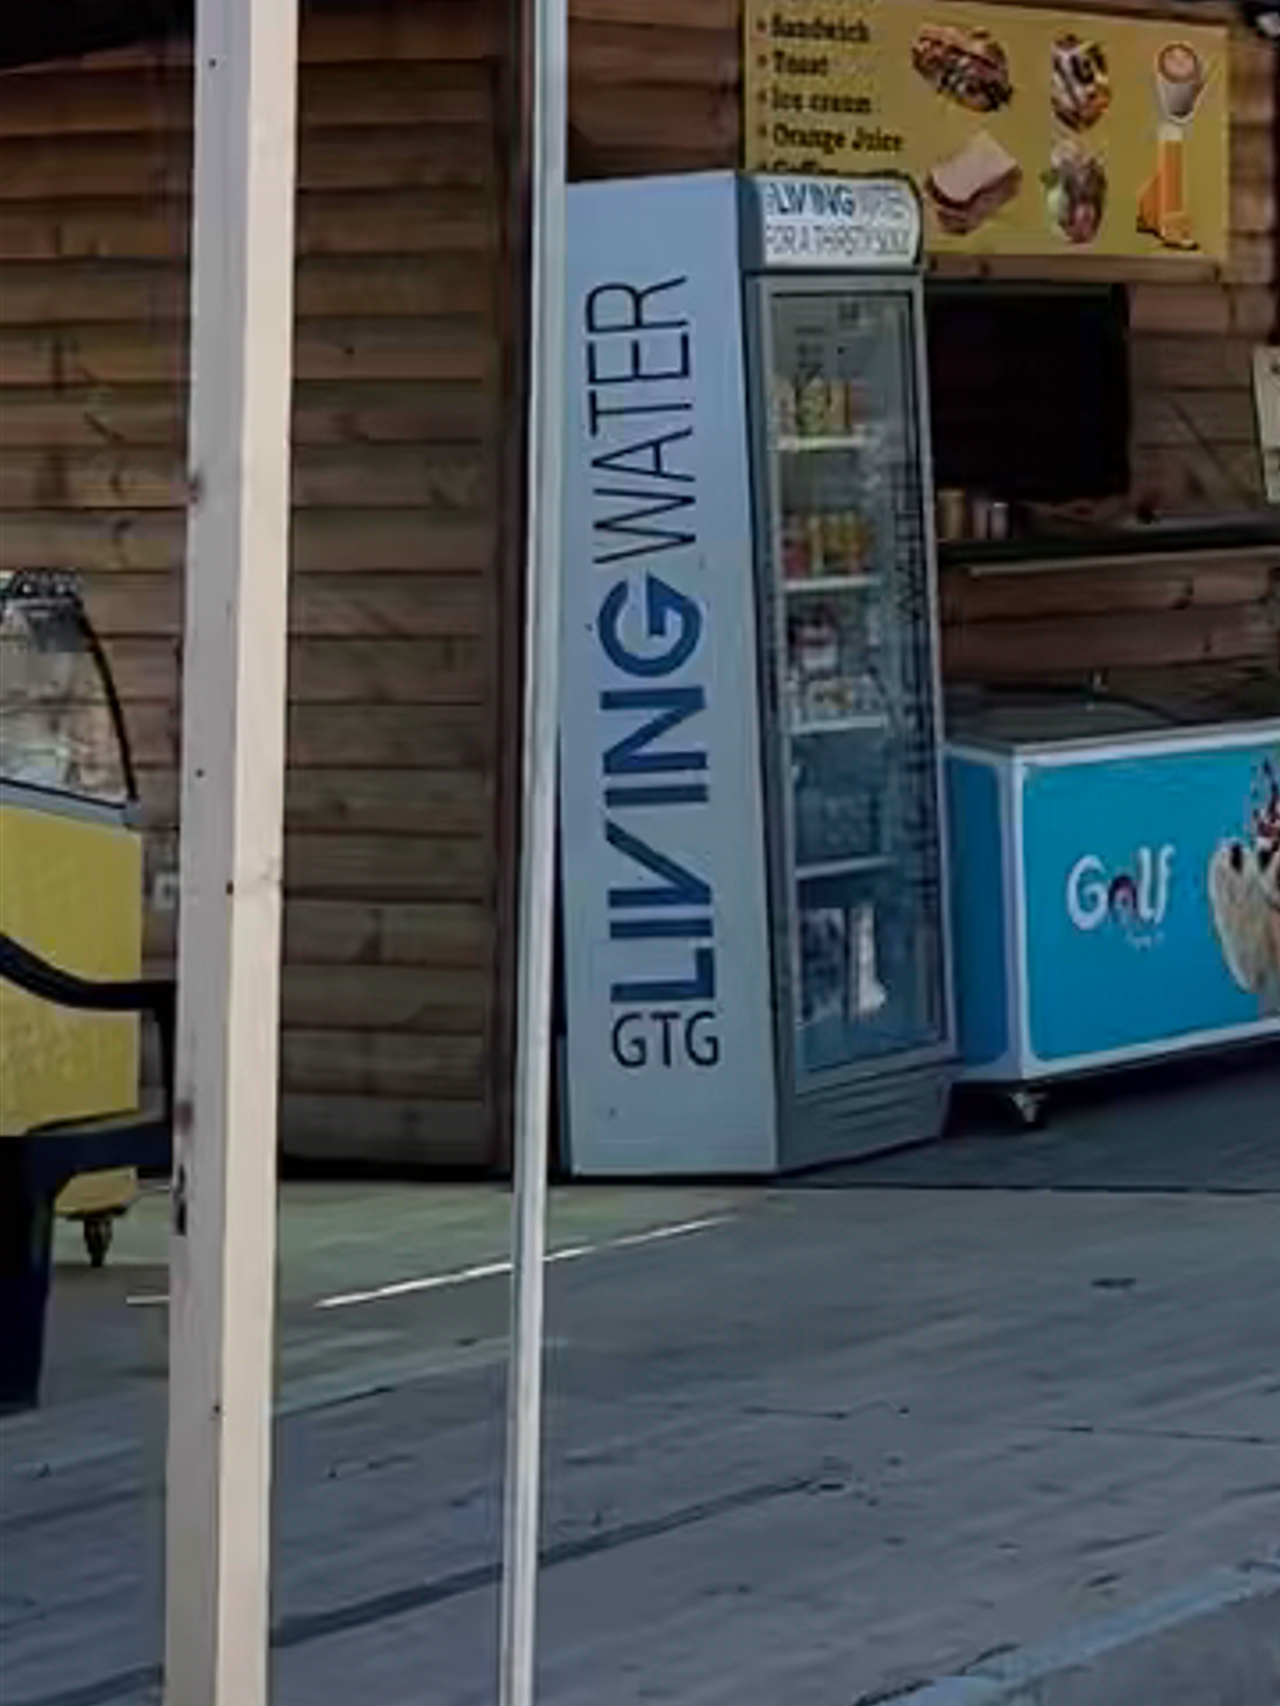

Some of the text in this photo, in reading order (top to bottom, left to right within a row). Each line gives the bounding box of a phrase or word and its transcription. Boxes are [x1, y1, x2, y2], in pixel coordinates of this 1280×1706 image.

[772, 13, 869, 41] Sandwich
[774, 50, 828, 75] Toast
[773, 87, 803, 110] Ice
[773, 123, 903, 154] Orange Juice
[585, 274, 717, 1004] LIVING WATER
[611, 1010, 720, 1068] GTG
